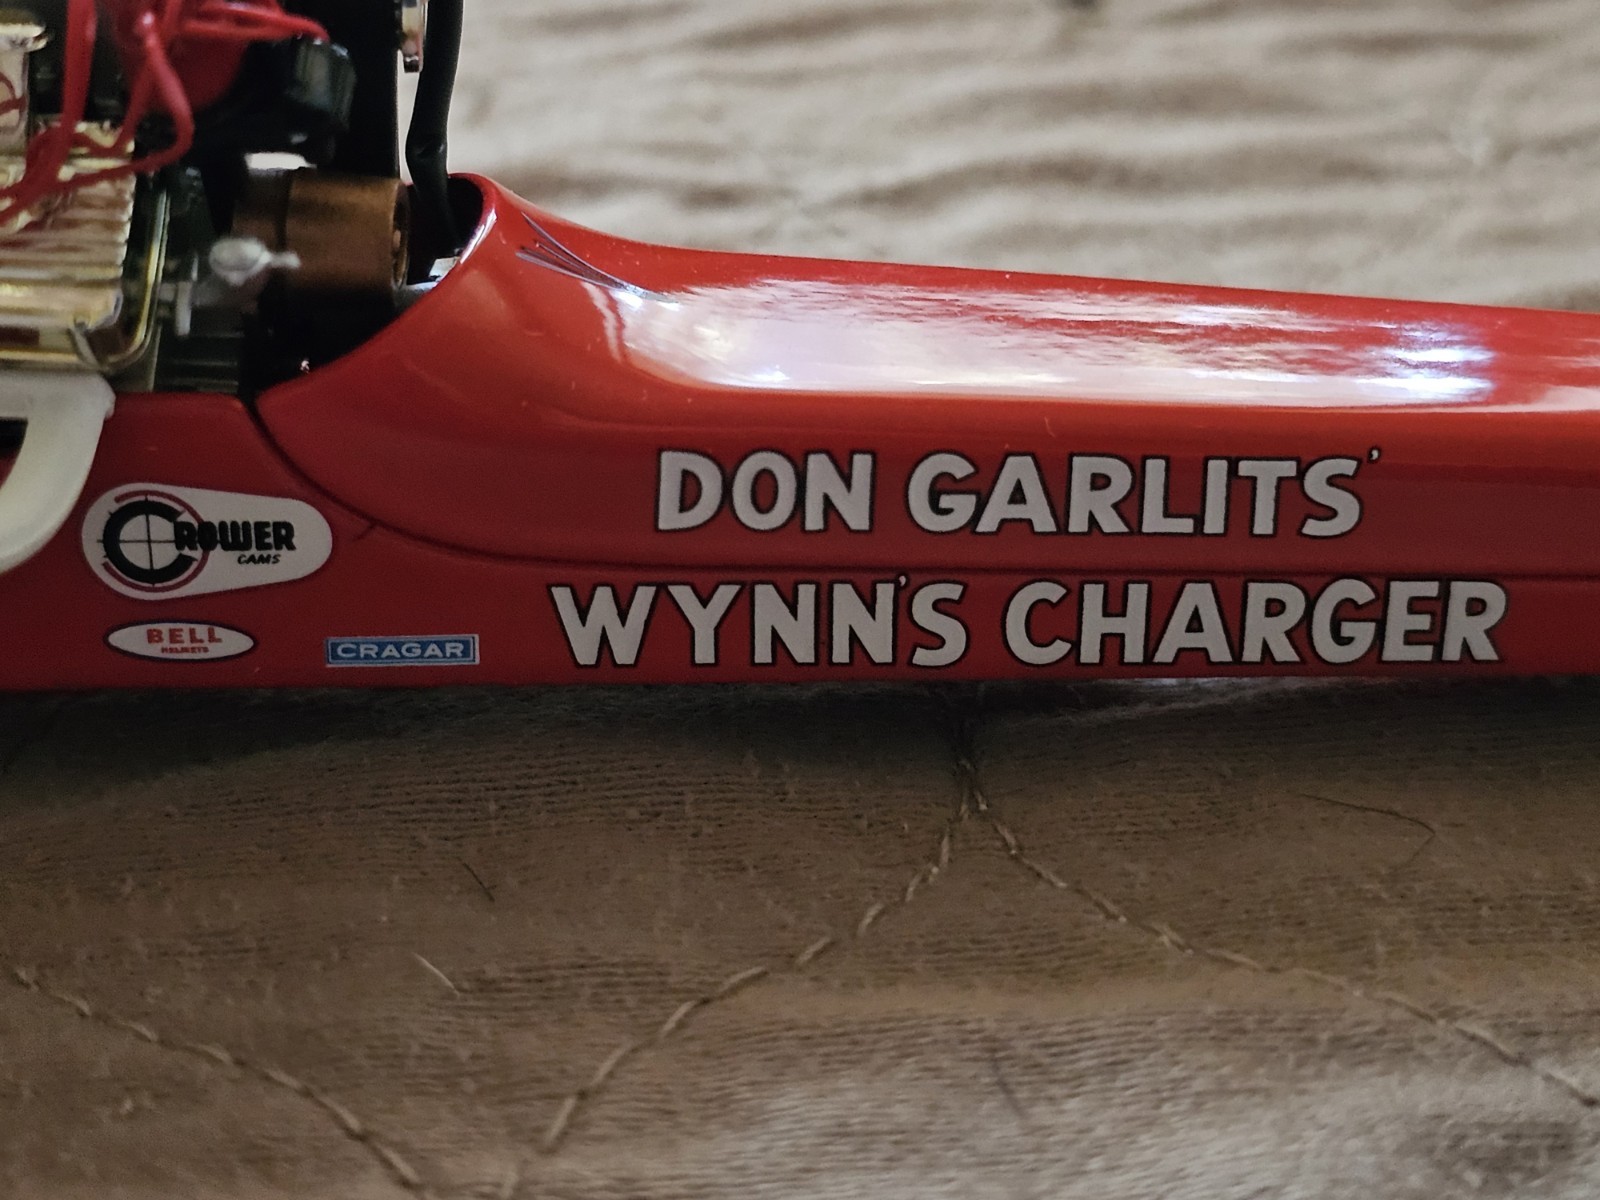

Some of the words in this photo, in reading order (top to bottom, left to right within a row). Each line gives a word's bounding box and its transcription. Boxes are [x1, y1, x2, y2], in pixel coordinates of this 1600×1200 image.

[656, 449, 875, 533] DON
[906, 447, 1381, 537] GARLITS'
[102, 500, 297, 584] CROWER
[237, 553, 281, 565] CAMS
[146, 626, 222, 644] BELL
[550, 575, 968, 667] WYNN'S
[1004, 577, 1508, 666] CHARGER
[336, 641, 464, 660] CRAGAR
